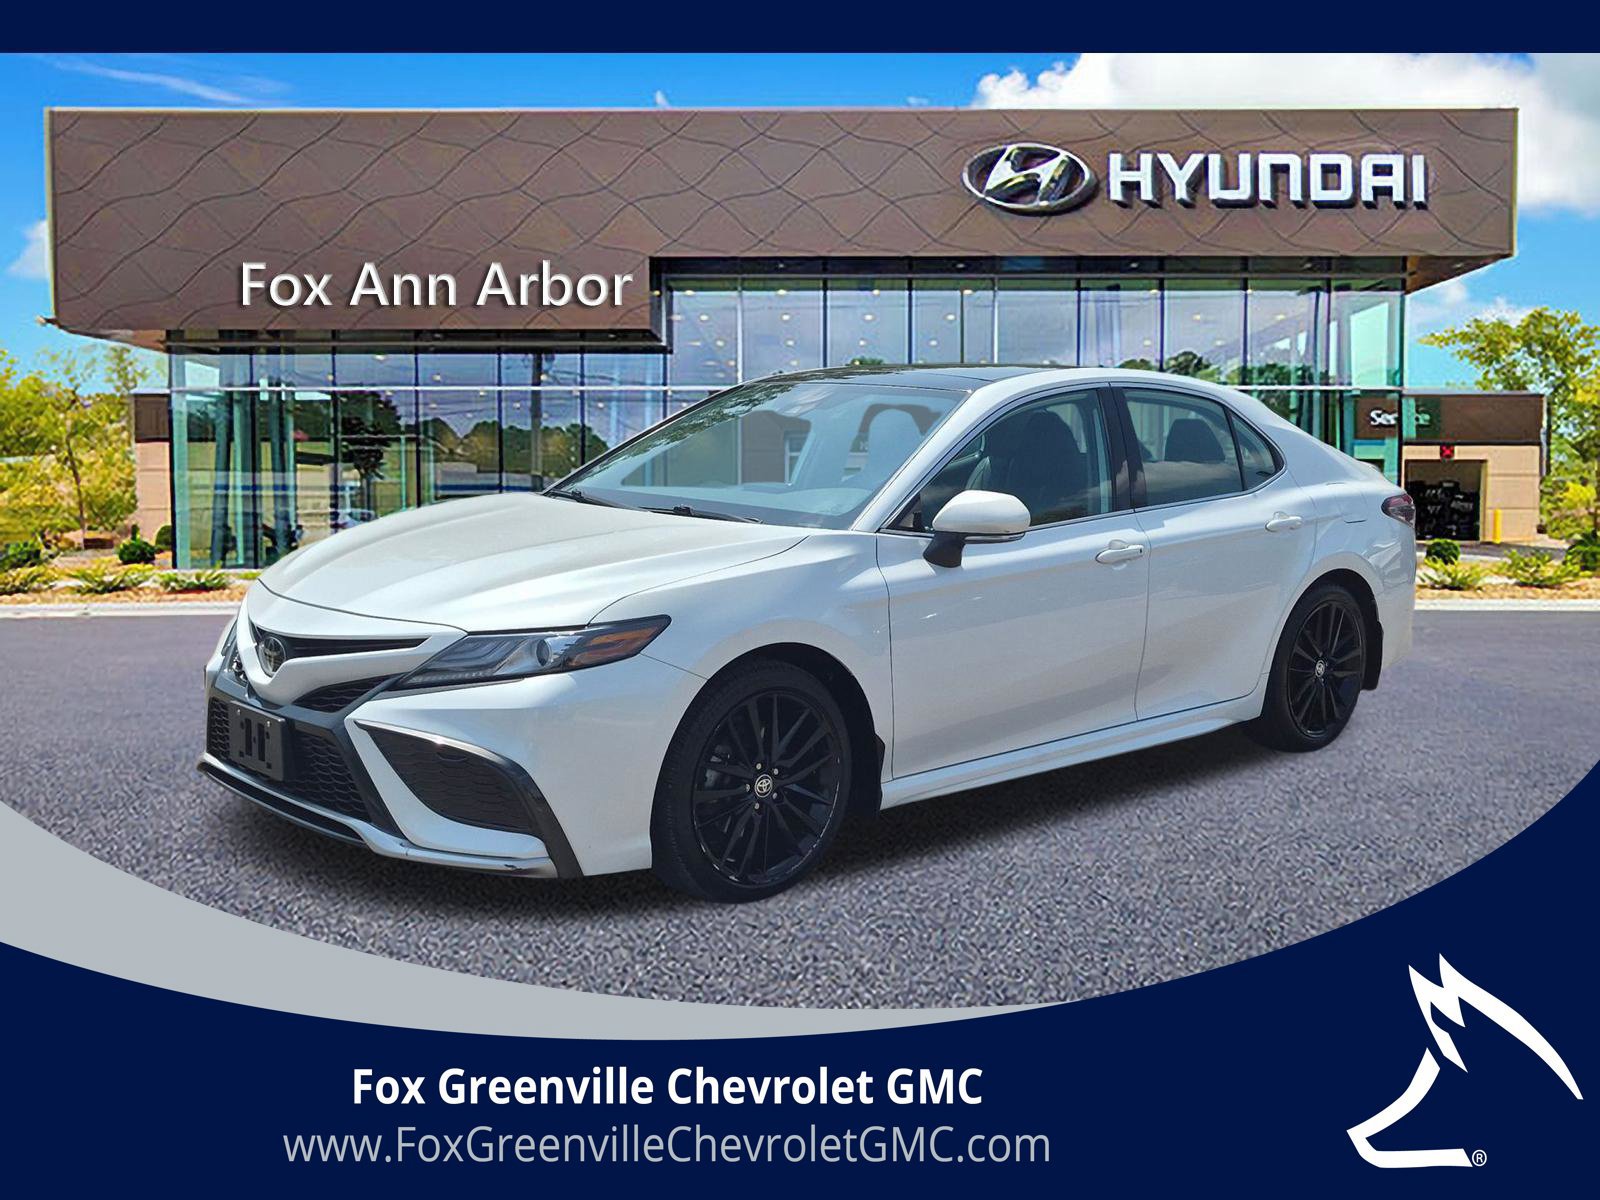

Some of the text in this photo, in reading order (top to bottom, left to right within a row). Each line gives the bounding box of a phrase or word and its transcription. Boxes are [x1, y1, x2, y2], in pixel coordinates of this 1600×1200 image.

[1109, 153, 1427, 205] HYUNDAI
[240, 259, 634, 308] Fox Ann Arbor
